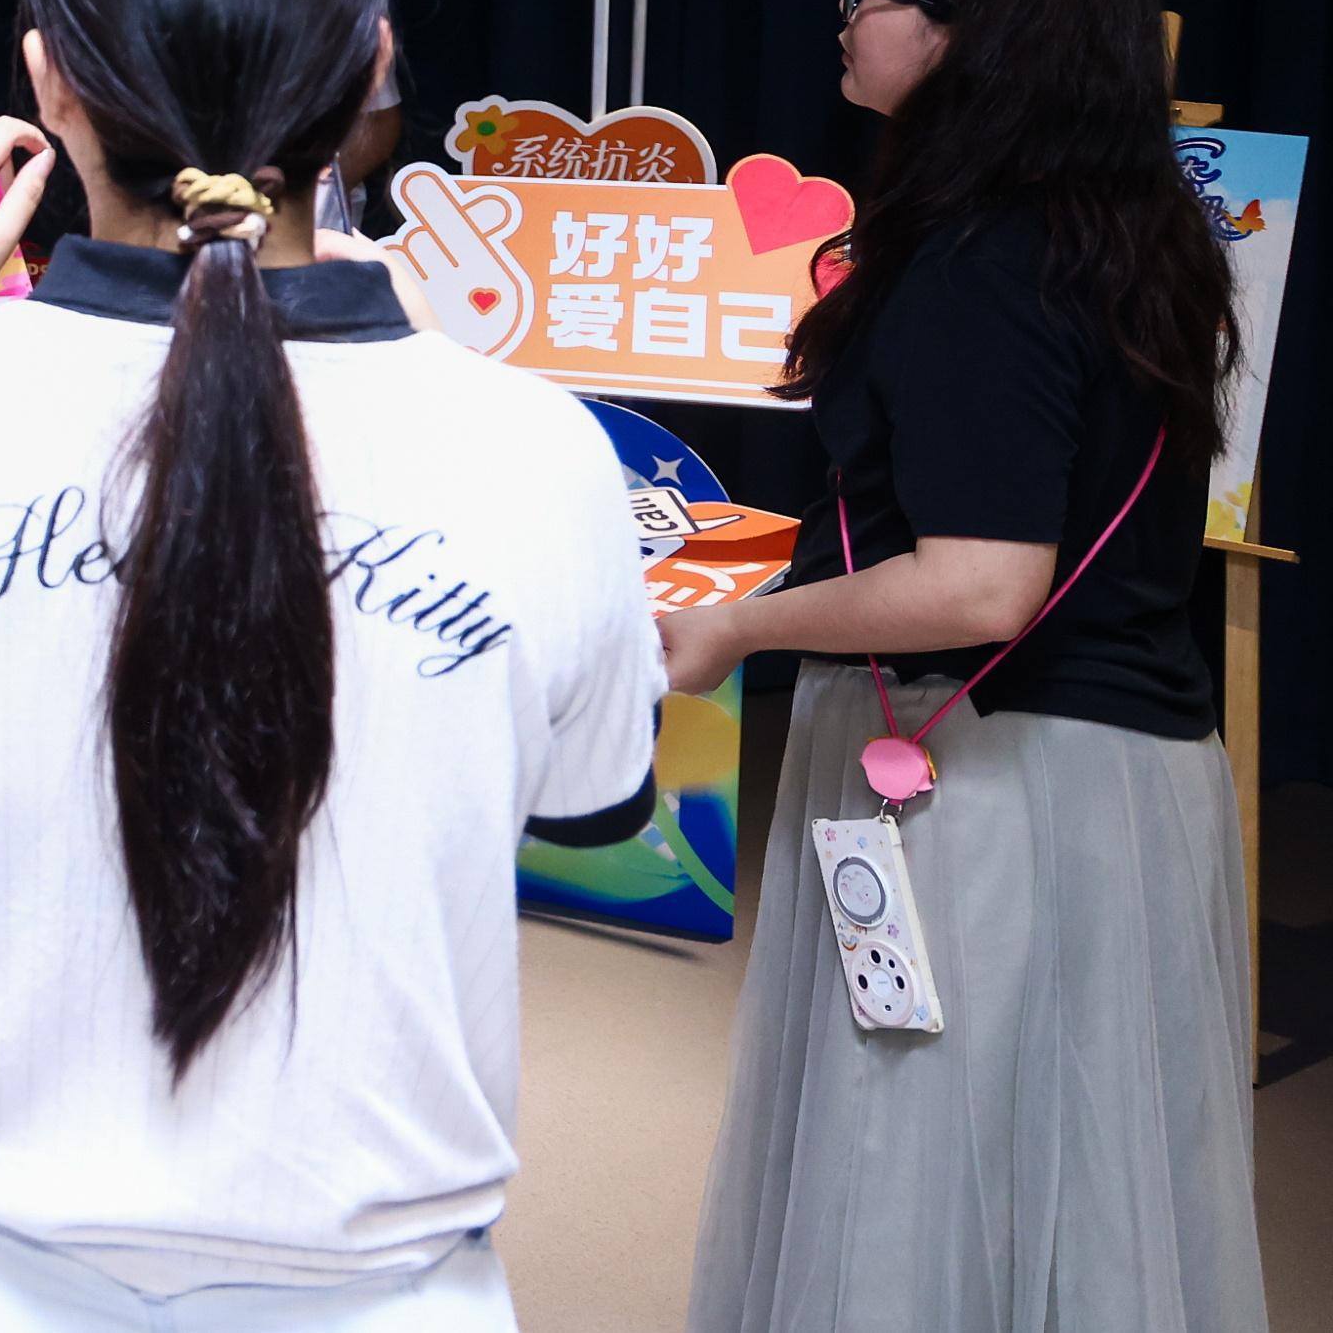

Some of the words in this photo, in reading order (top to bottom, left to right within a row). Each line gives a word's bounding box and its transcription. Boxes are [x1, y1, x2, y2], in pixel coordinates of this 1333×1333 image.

[492, 134, 677, 183] 系统抗炎
[547, 210, 714, 283] 好好
[545, 286, 792, 361] 爱自己
[319, 510, 513, 679] Kitty
